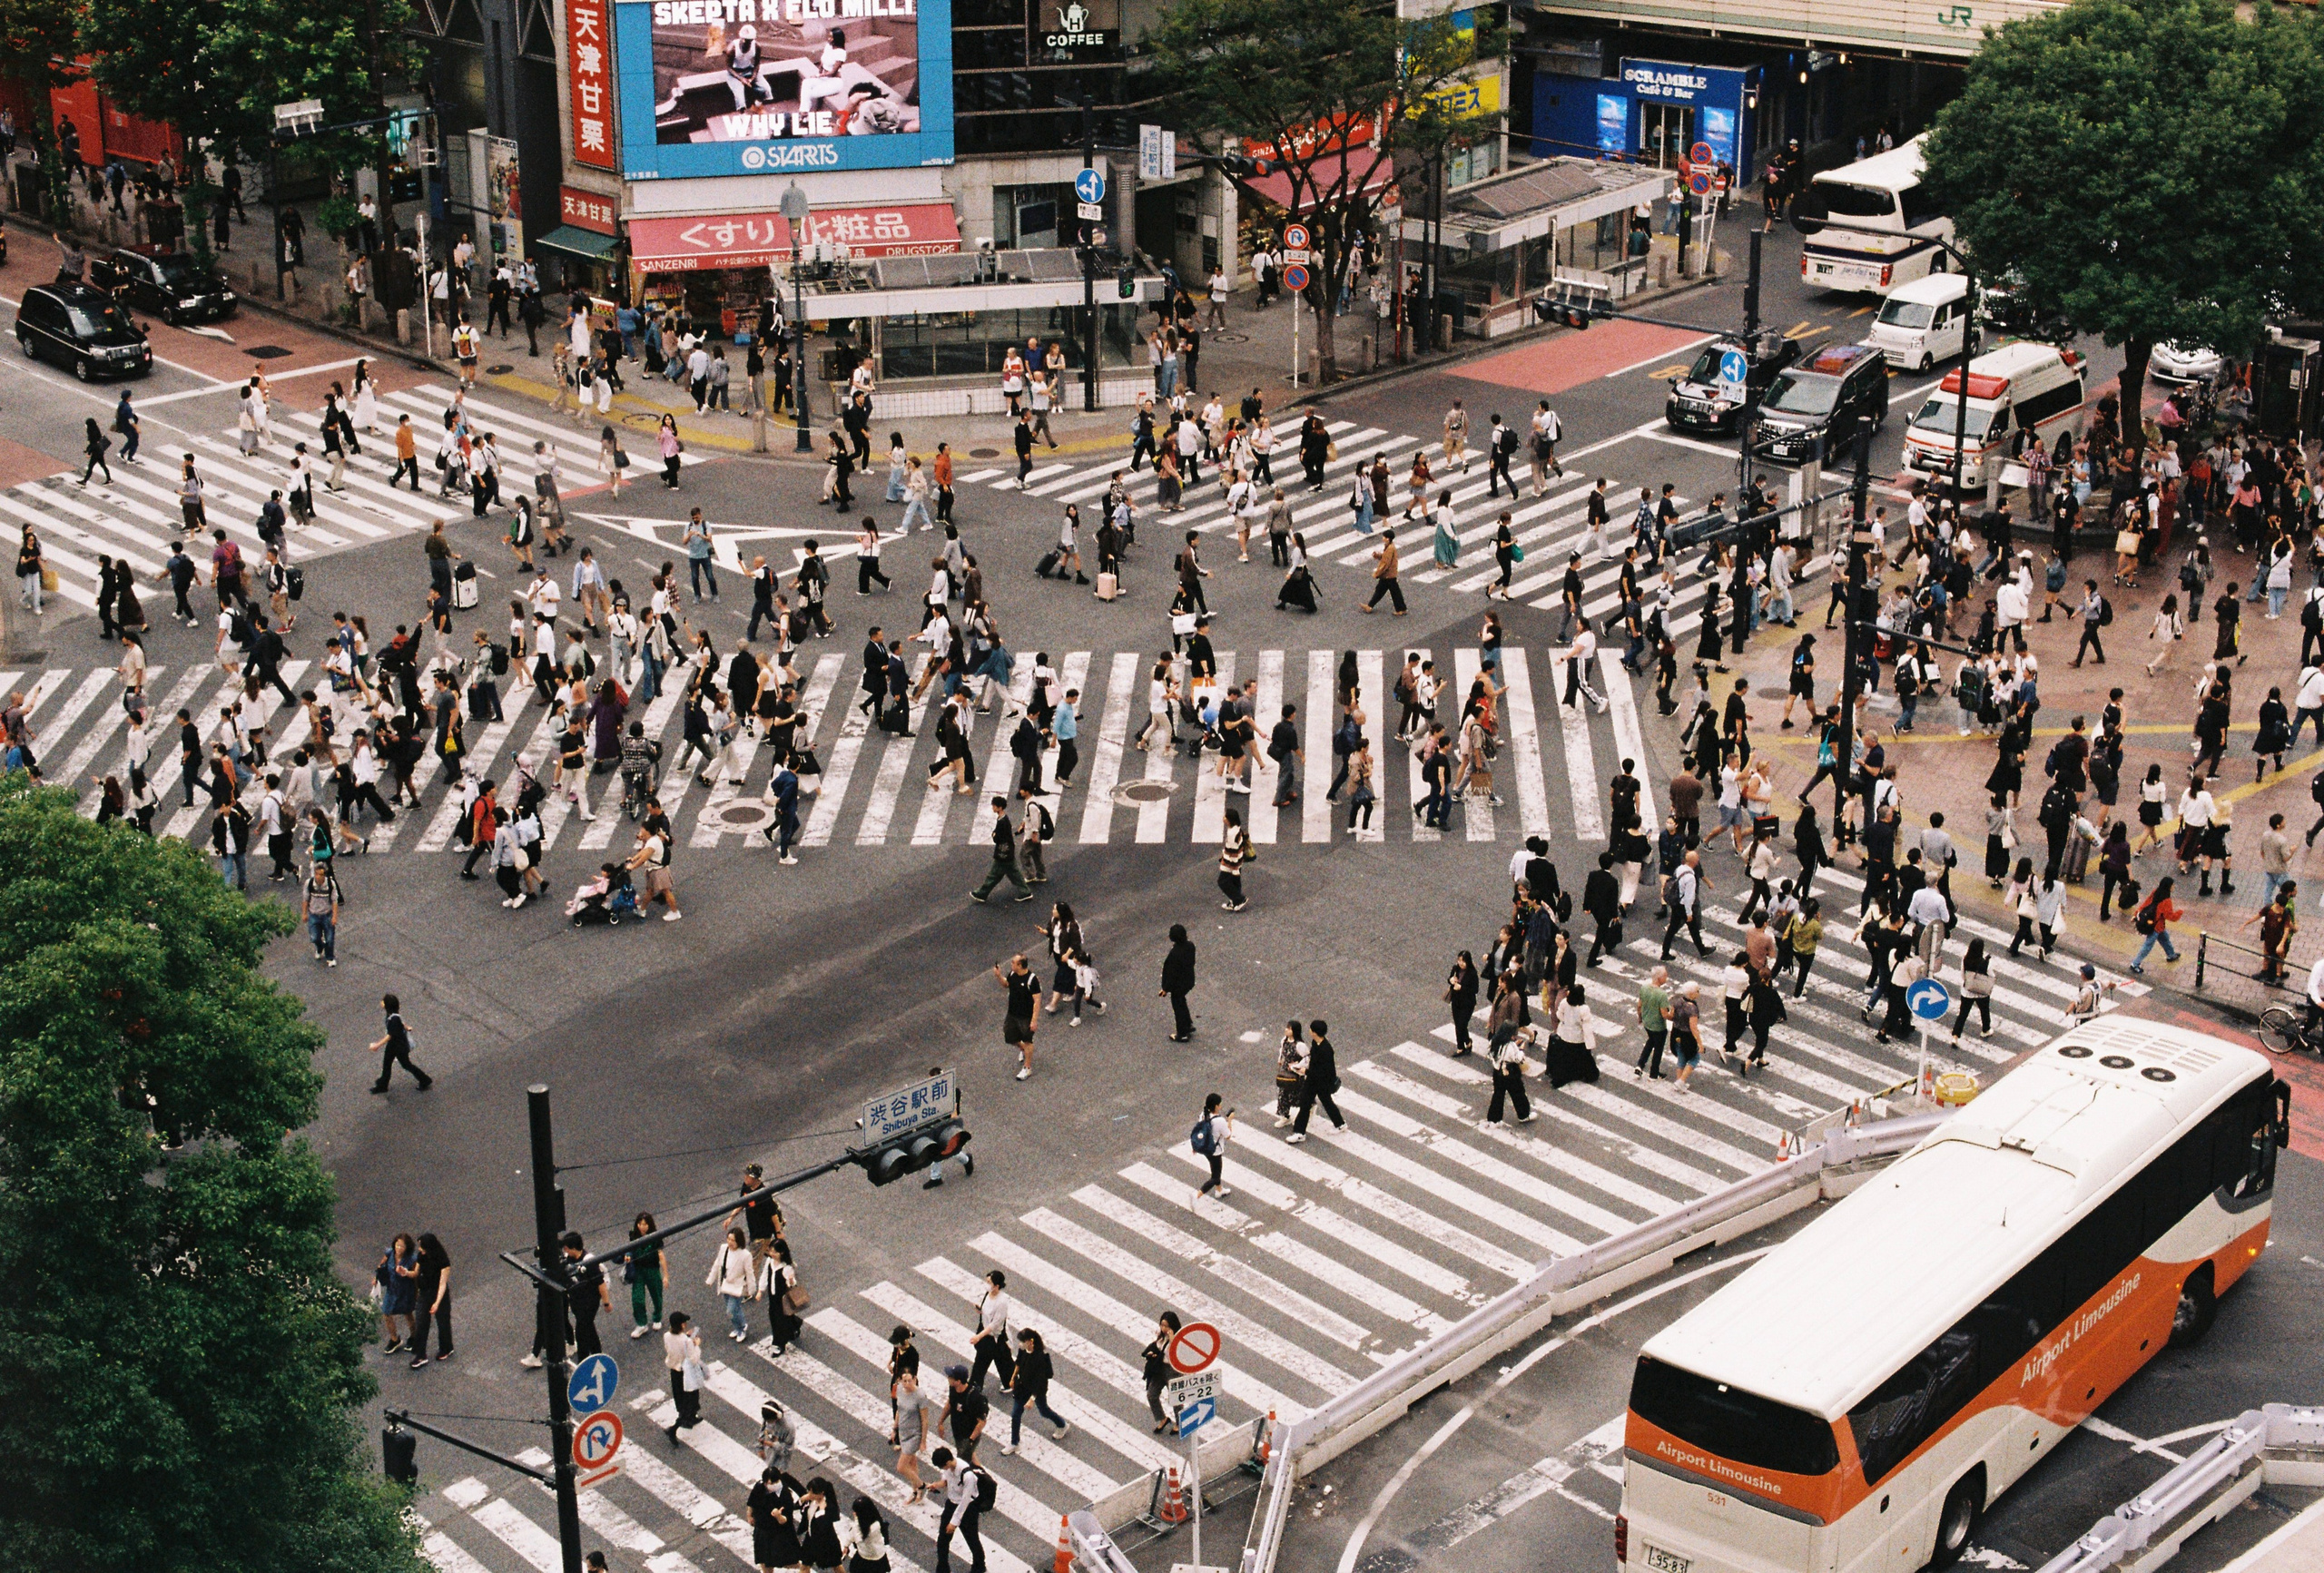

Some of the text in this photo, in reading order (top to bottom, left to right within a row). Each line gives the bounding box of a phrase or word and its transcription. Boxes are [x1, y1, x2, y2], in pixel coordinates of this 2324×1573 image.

[655, 0, 755, 25] SKEPTA
[763, 0, 779, 21] X
[1938, 5, 1973, 27] JR
[1047, 33, 1104, 47] COFFEE
[574, 0, 606, 152] 天津甘栗
[1624, 69, 1707, 89] SCRAMBLE
[1636, 84, 1695, 99] Café & Bar
[723, 113, 785, 139] WHY
[500, 139, 517, 150] PIECE
[1148, 130, 1157, 176] 渋谷駅前
[1252, 145, 1275, 158] GINZA
[564, 196, 613, 224] 天津甘栗
[680, 212, 911, 248] くすり 化粧品
[886, 245, 955, 257] DRUGSTORE
[640, 258, 697, 272] SANZENRI
[870, 1079, 948, 1126] 渋谷駅前
[882, 1106, 940, 1135] Shibuya Sta.
[2020, 1273, 2141, 1389] Airport Limousine
[1170, 1372, 1219, 1391] 路線バスを除く
[1657, 1440, 1782, 1495] Airport Limousine
[1707, 1492, 1727, 1507] 531
